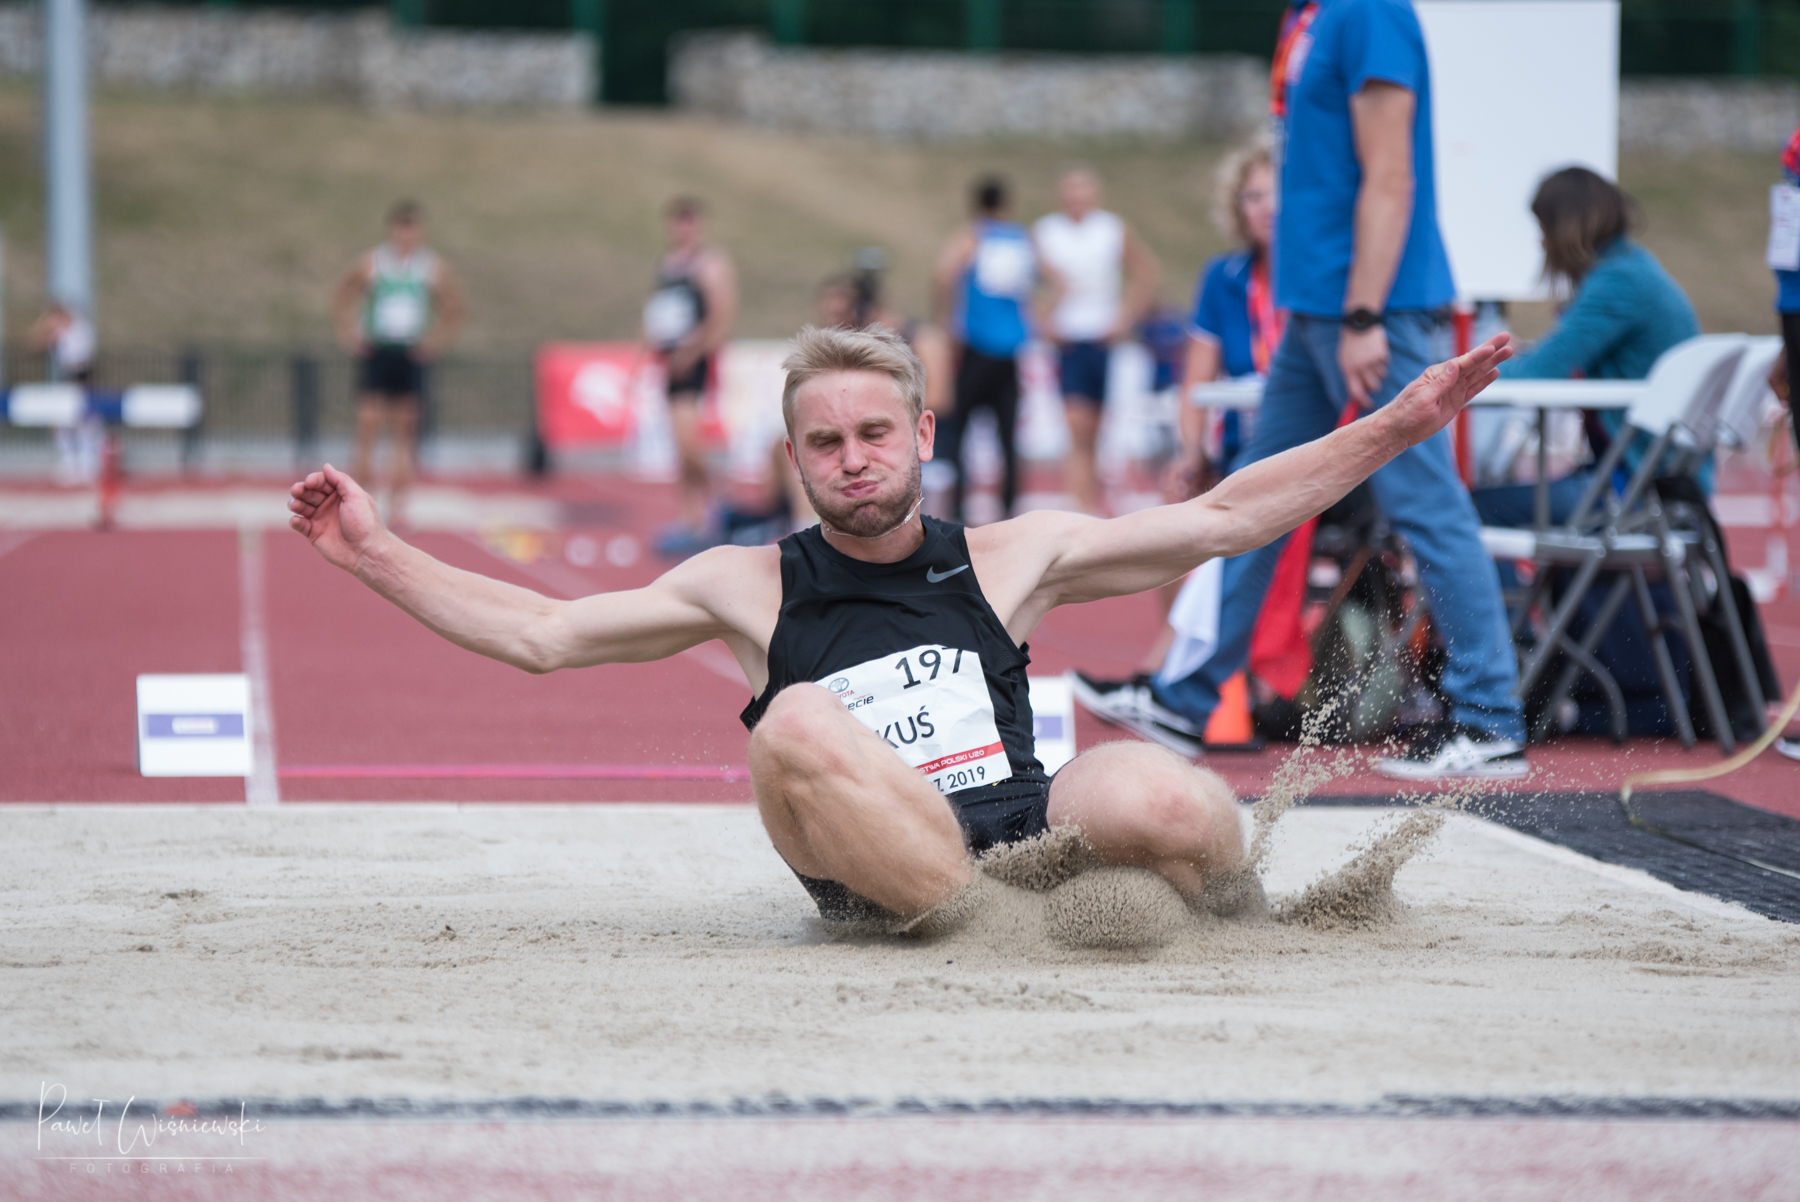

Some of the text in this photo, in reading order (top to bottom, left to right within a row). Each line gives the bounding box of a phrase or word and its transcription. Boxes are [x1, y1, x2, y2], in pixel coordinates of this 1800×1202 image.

[895, 646, 963, 690] 197
[941, 754, 968, 767] POLSKI
[968, 749, 985, 759] U20
[947, 765, 985, 789] 2019
